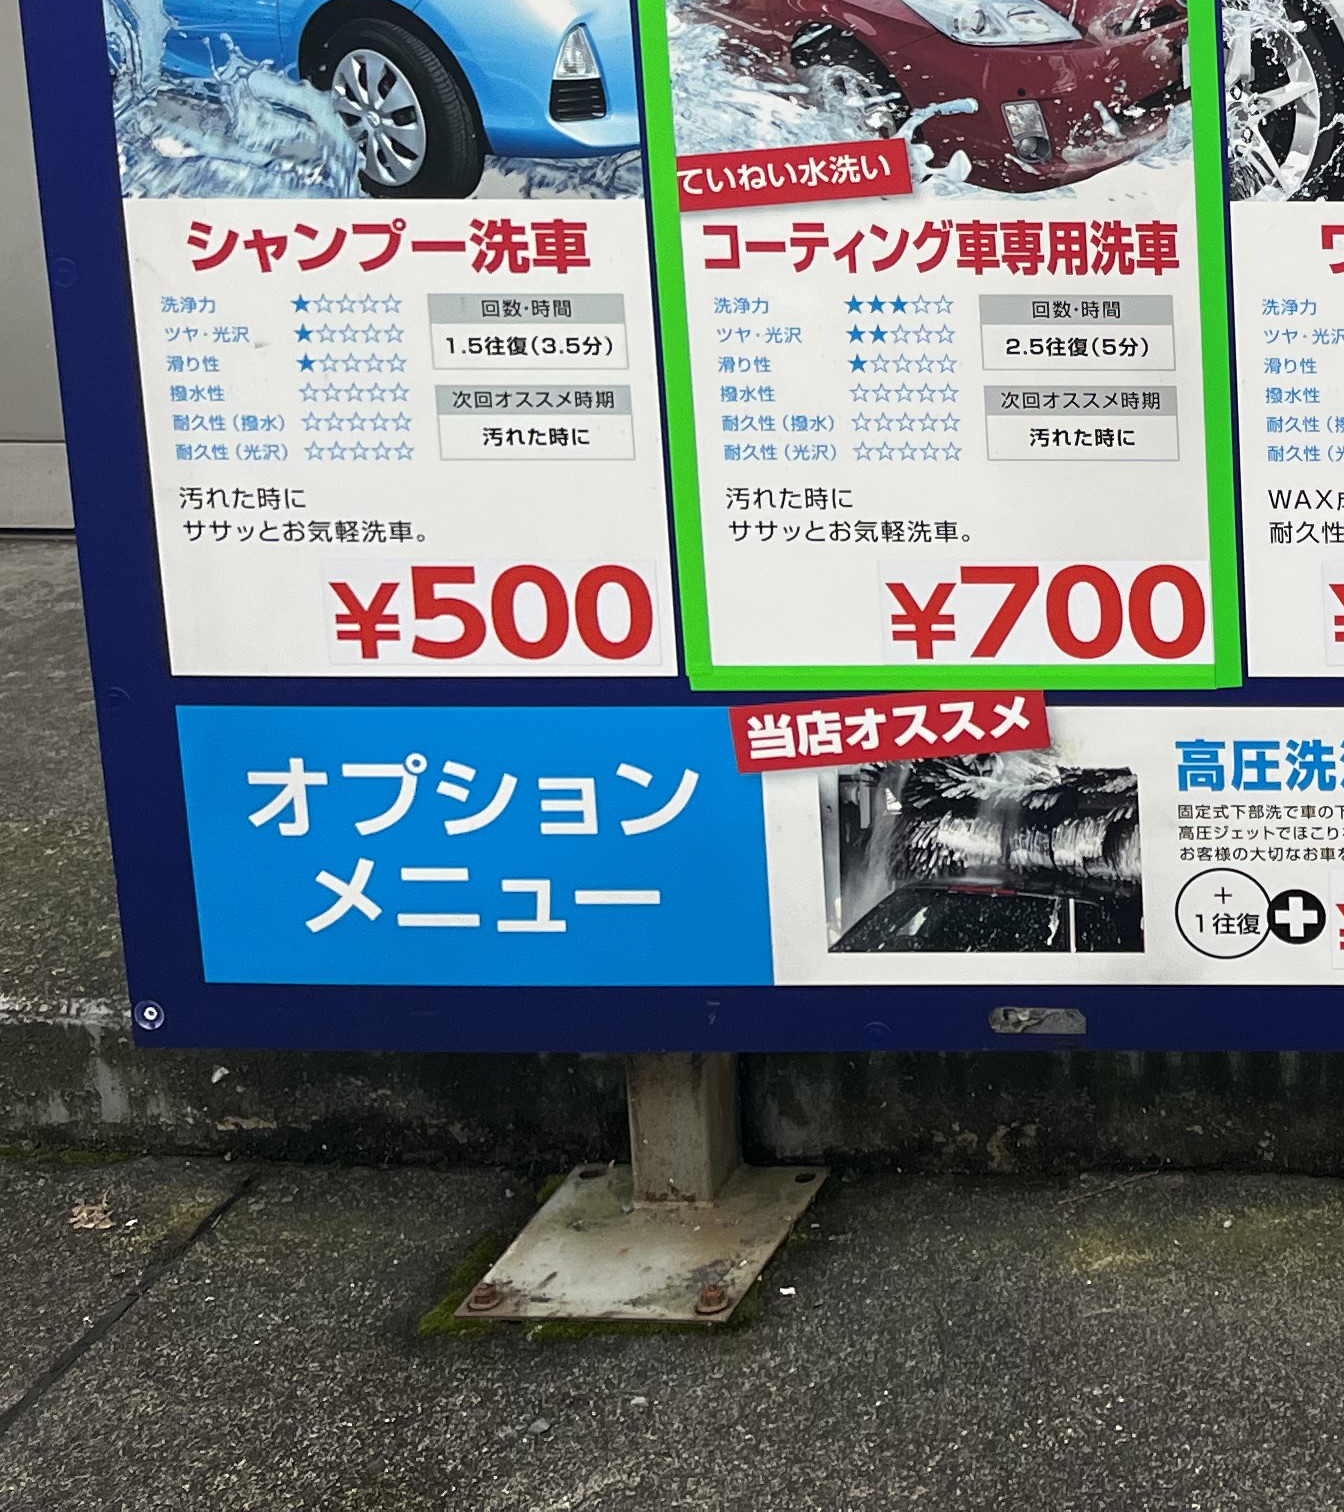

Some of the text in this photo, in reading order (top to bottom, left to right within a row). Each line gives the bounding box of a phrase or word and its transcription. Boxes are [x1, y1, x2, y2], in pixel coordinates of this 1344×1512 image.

[678, 154, 892, 195] ていねい水洗い
[187, 218, 590, 274] シャンプー洗車
[703, 219, 1179, 276] コーティング車専用洗車
[161, 296, 215, 313] 洗浄力
[481, 300, 571, 317] 回数・時間
[714, 297, 768, 314] 洗浄力
[1032, 301, 1120, 318] 回数・時間
[1262, 299, 1316, 315] 洗浄力
[446, 336, 612, 356] 1.5往復(3.5分)
[1006, 337, 1148, 357] 2.5往復(5分)
[167, 356, 220, 372] 滑り性
[718, 356, 771, 373] 滑り性
[1264, 358, 1317, 374] 滑り性
[170, 385, 225, 402] 撥水性
[453, 391, 614, 408] 次回オススメ時期
[720, 385, 775, 402] 撥水性
[1001, 392, 1160, 409] 次回オススメ時期
[1266, 387, 1320, 403] 撥水性
[483, 427, 589, 446] 汚れた時に
[1030, 428, 1135, 447] 汚れた時に
[179, 487, 306, 510] 汚れた時に
[726, 487, 853, 510] 汚れた時に
[183, 520, 425, 543] ササッとお気軽洗車。
[729, 520, 970, 543] ササッとお気軽洗車。
[329, 565, 653, 660] ¥500
[885, 564, 1205, 659] ¥700
[748, 696, 1030, 759] 当店オススメ
[248, 753, 699, 836] オプション
[306, 858, 660, 932] メニュー
[1196, 913, 1260, 935] 1往復
